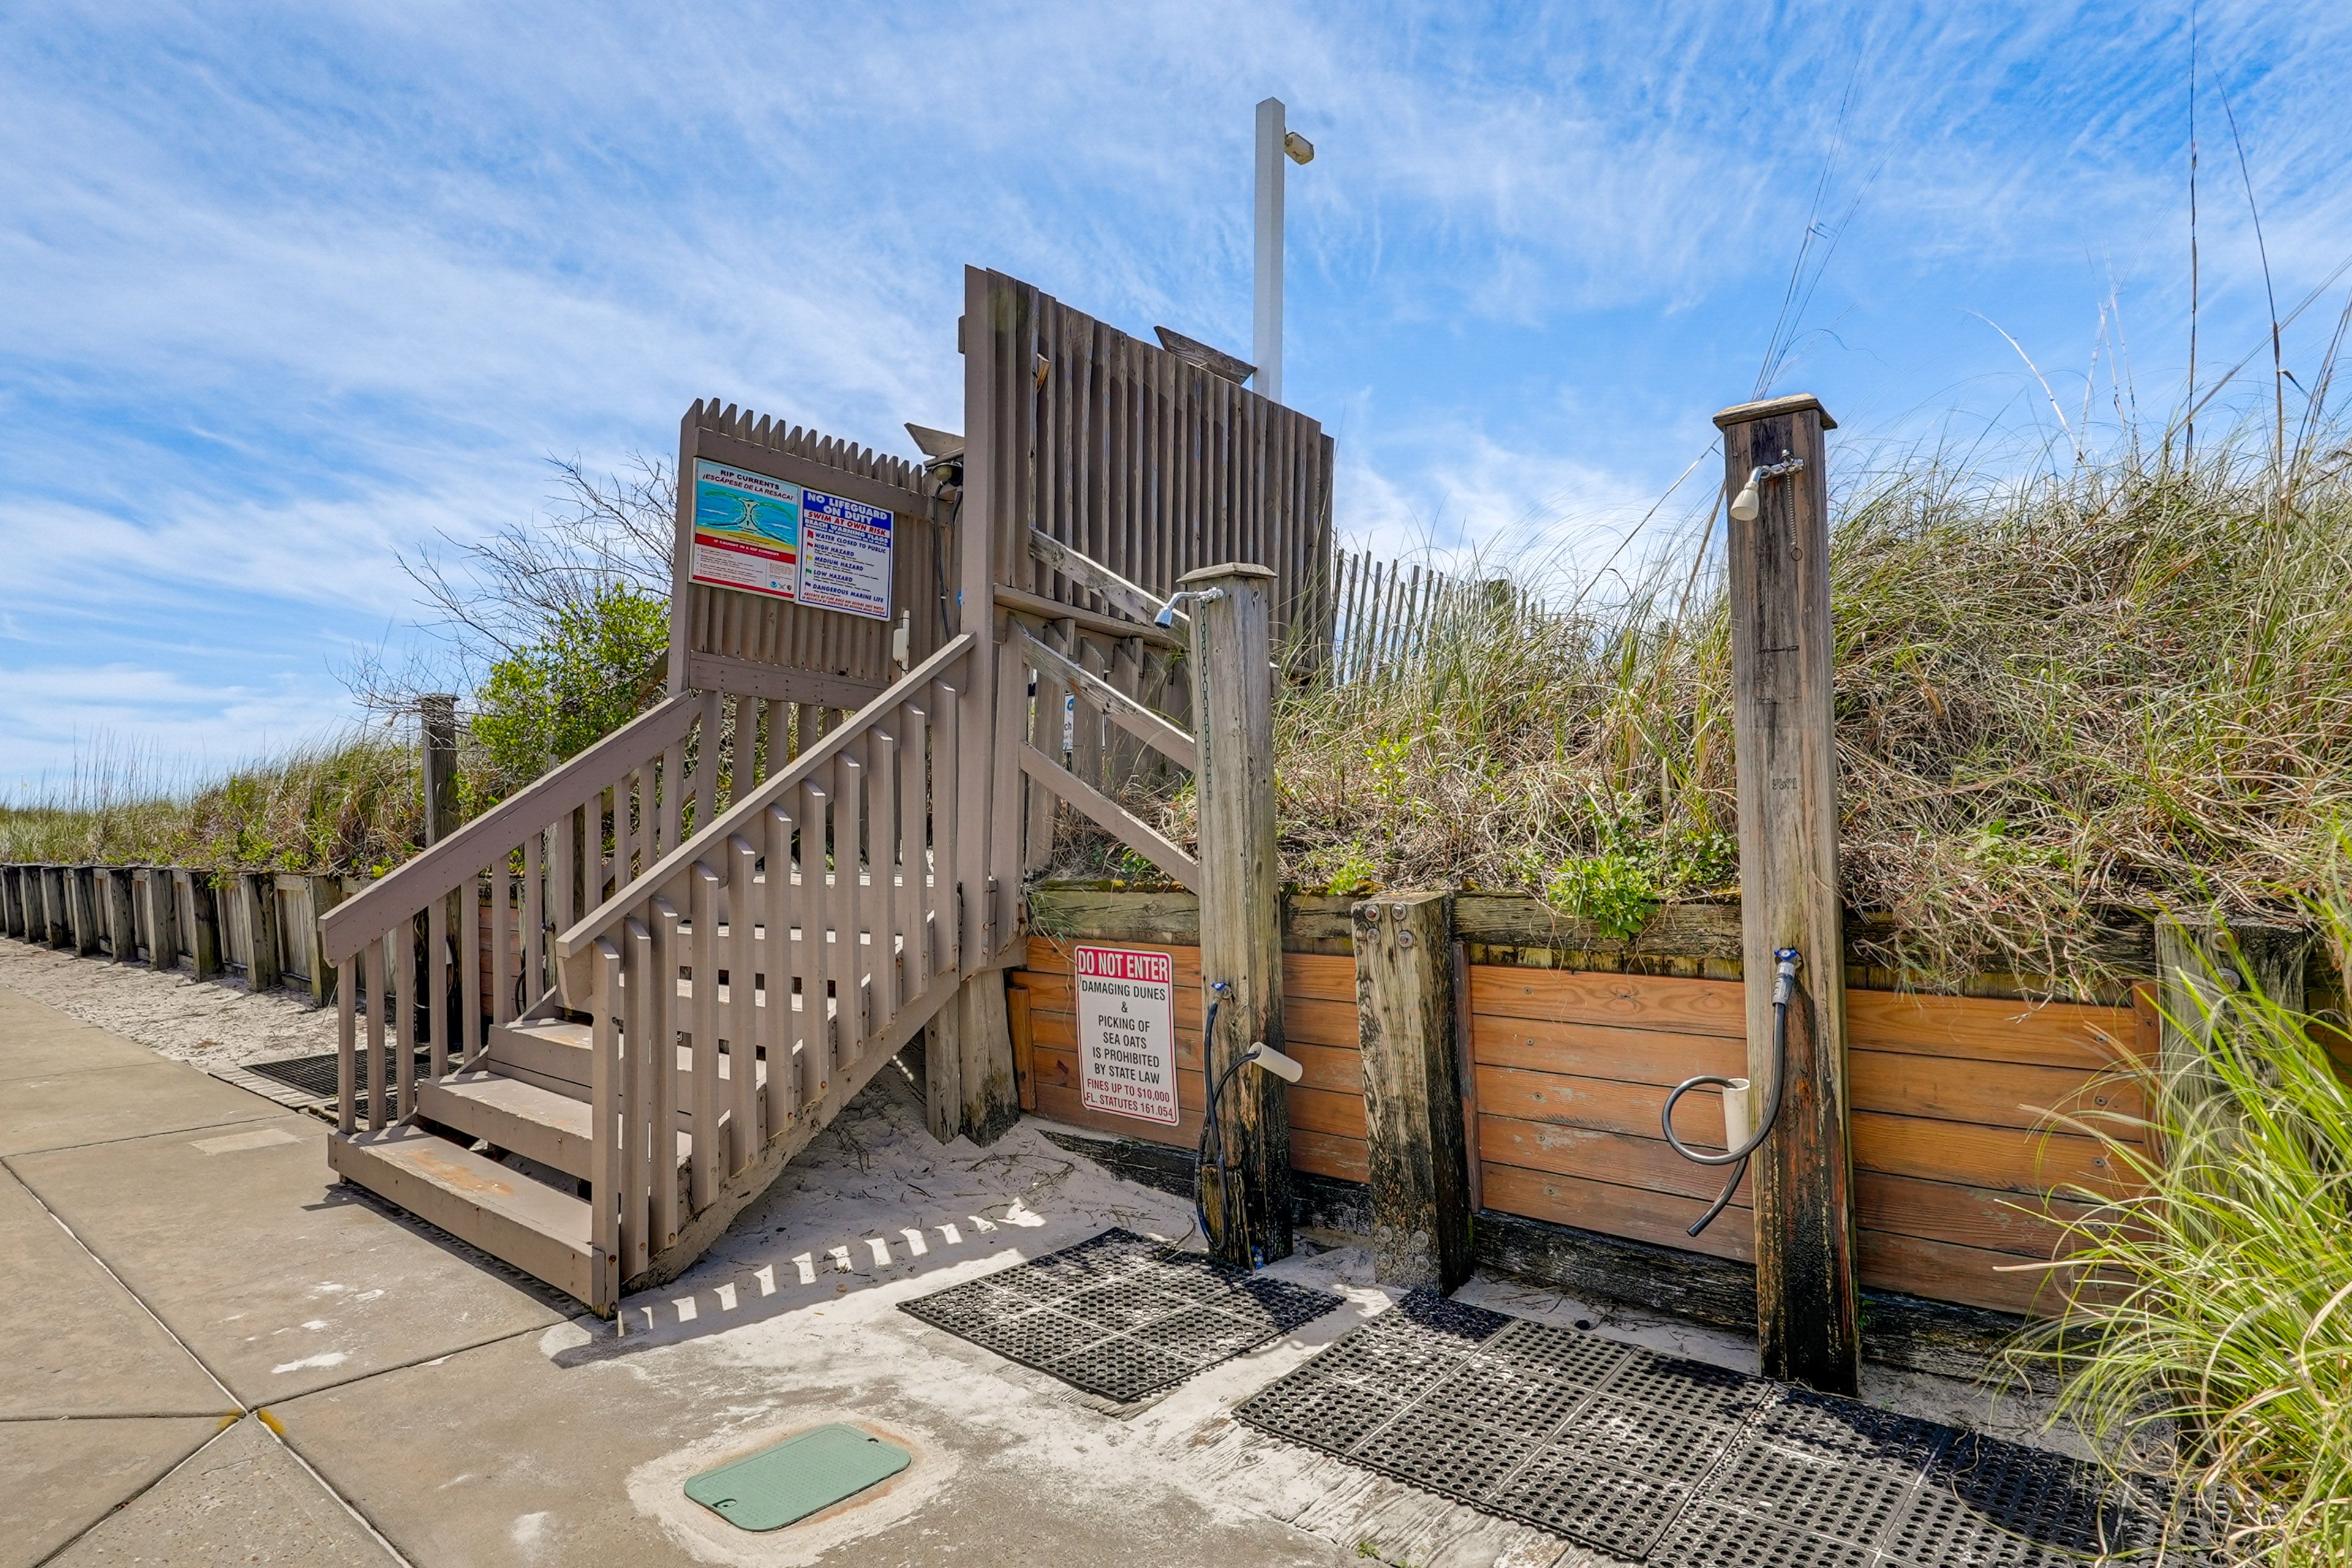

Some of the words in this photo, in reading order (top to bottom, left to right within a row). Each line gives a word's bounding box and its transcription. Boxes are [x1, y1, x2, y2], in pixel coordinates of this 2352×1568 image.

[737, 474, 780, 490] CURRENTS
[764, 488, 793, 500] RESACA!
[807, 492, 824, 504] NO
[829, 498, 887, 521] LIFEGUARD
[823, 505, 840, 516] ON
[844, 510, 872, 524] DUTY
[808, 511, 831, 522] SWIM
[847, 521, 867, 531] OWN
[869, 526, 886, 536] RISK
[815, 532, 834, 541] WATER
[837, 537, 857, 546] CLOSED
[868, 545, 886, 554] PUBLIC
[830, 524, 865, 538] WARNING
[867, 533, 888, 543] FLAGS
[831, 546, 854, 557] HAZARD
[814, 555, 838, 565] MEDIUM
[840, 561, 863, 571] HAZARD
[829, 572, 853, 582] HAZARD
[813, 583, 848, 595] DANGEROUS
[850, 591, 871, 600] MARINE
[1078, 951, 1095, 974] DO
[1098, 952, 1123, 976] NOT
[1126, 954, 1168, 981] ENTER
[1082, 980, 1130, 997] DAMAGING
[1134, 986, 1165, 1001] DUNES
[1121, 1001, 1128, 1013] &
[1098, 1015, 1134, 1030] PICKING
[1138, 1020, 1150, 1032] OF
[1103, 1031, 1120, 1045] SEA
[1123, 1035, 1147, 1049] OATS
[1093, 1046, 1101, 1058] IS
[1104, 1049, 1159, 1068] PROHIBITED
[1095, 1063, 1106, 1075] BY
[1109, 1065, 1136, 1080] STATE
[1139, 1070, 1159, 1084] LAW
[1087, 1079, 1109, 1091] FINES
[1112, 1082, 1122, 1093] UP
[1125, 1085, 1134, 1096] TO
[1137, 1087, 1169, 1102] $10,000
[1087, 1092, 1098, 1103] FL.
[1100, 1095, 1138, 1111] STATUTES
[1140, 1103, 1174, 1118] 161.054
